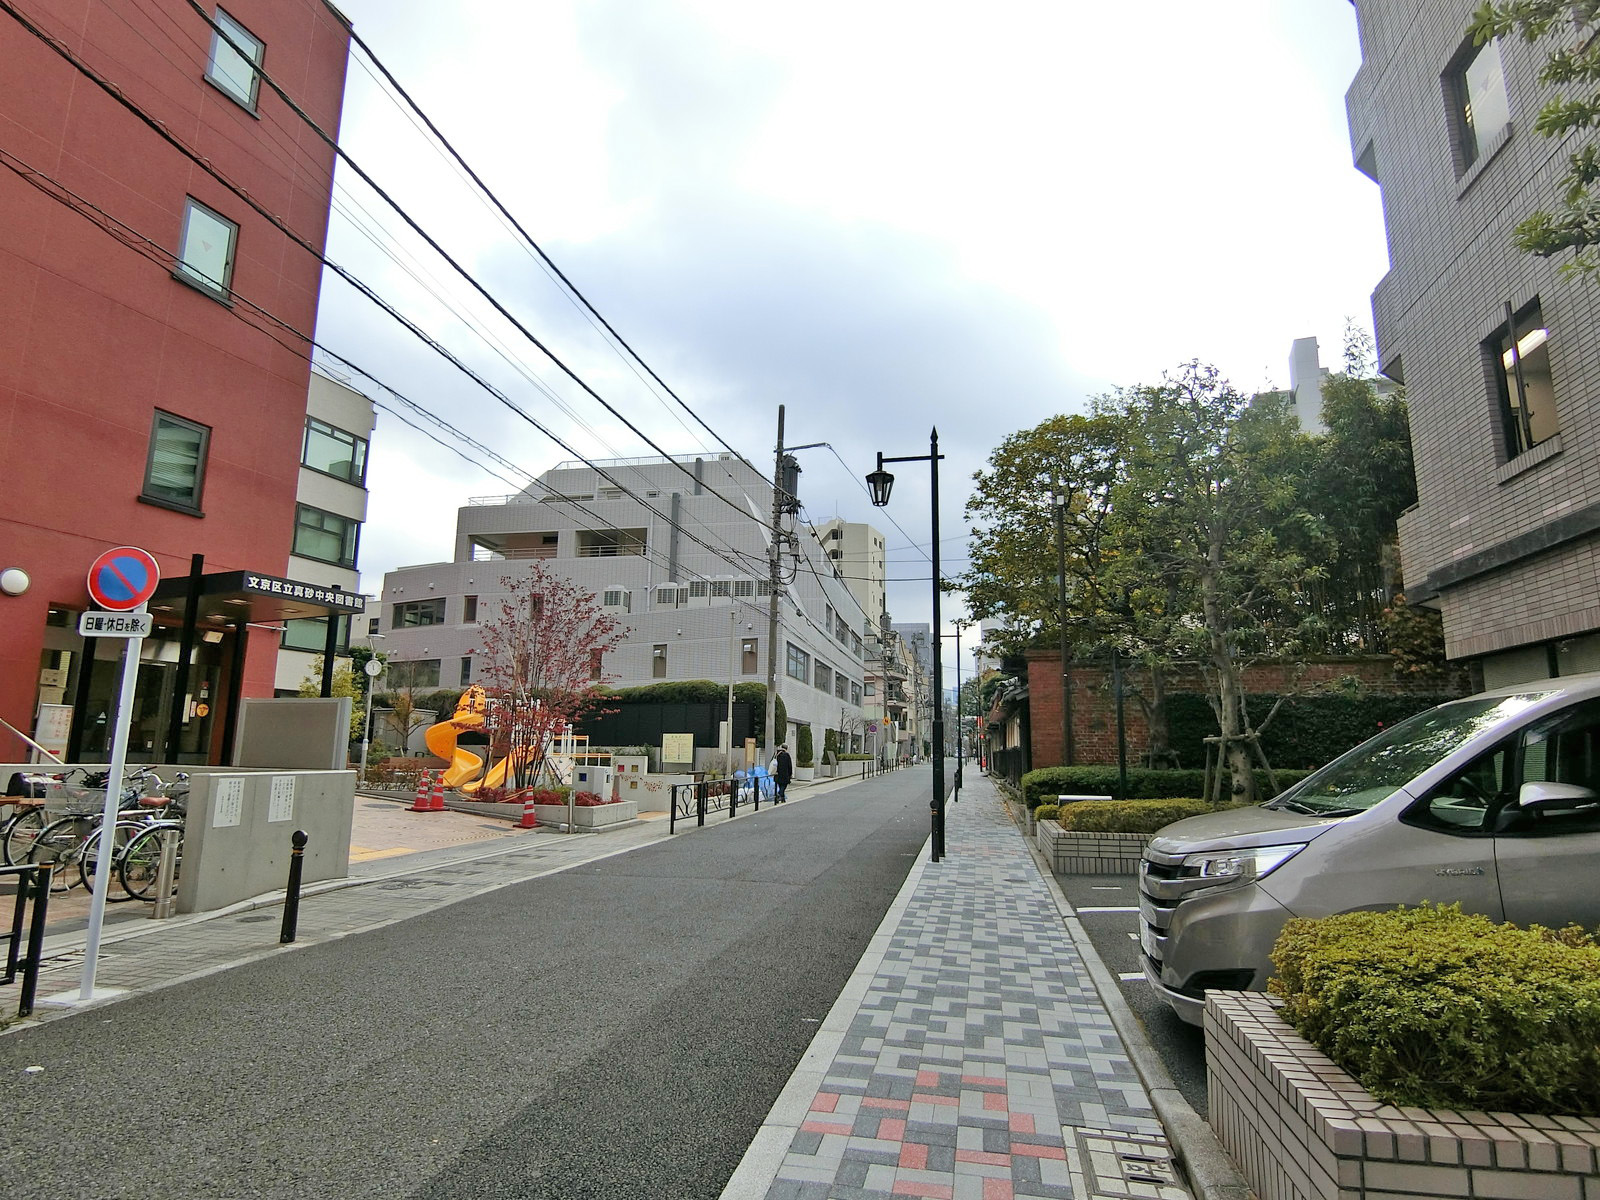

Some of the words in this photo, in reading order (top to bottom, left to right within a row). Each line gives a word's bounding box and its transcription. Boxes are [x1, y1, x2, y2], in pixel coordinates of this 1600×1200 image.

[248, 576, 363, 608] 文京区立真砂中央図書館
[85, 617, 146, 632] 日曜・休日を除く
